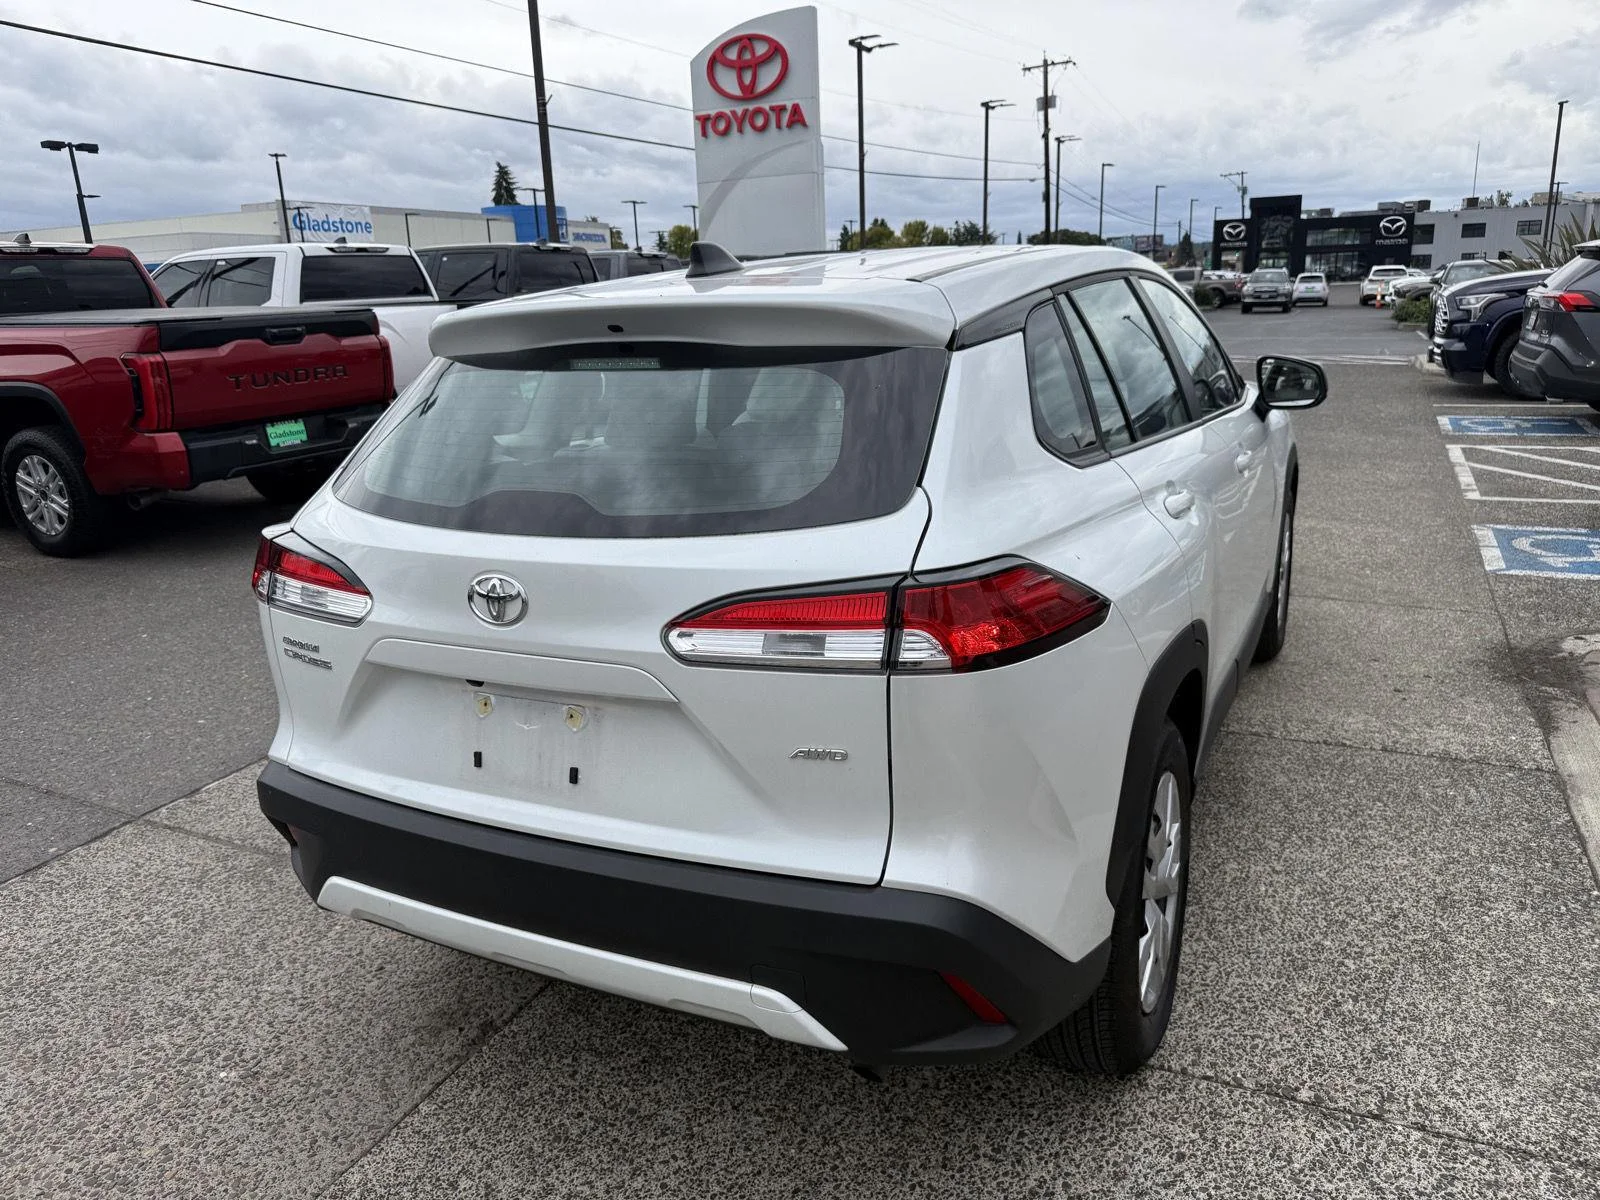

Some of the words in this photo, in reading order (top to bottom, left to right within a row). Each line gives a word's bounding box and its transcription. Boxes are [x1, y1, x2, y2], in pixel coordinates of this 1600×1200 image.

[695, 102, 809, 139] TOYOTA
[292, 212, 373, 234] Gladstone
[227, 365, 349, 392] TUNDRA
[270, 429, 305, 440] Gladstone
[788, 748, 849, 761] AWD
